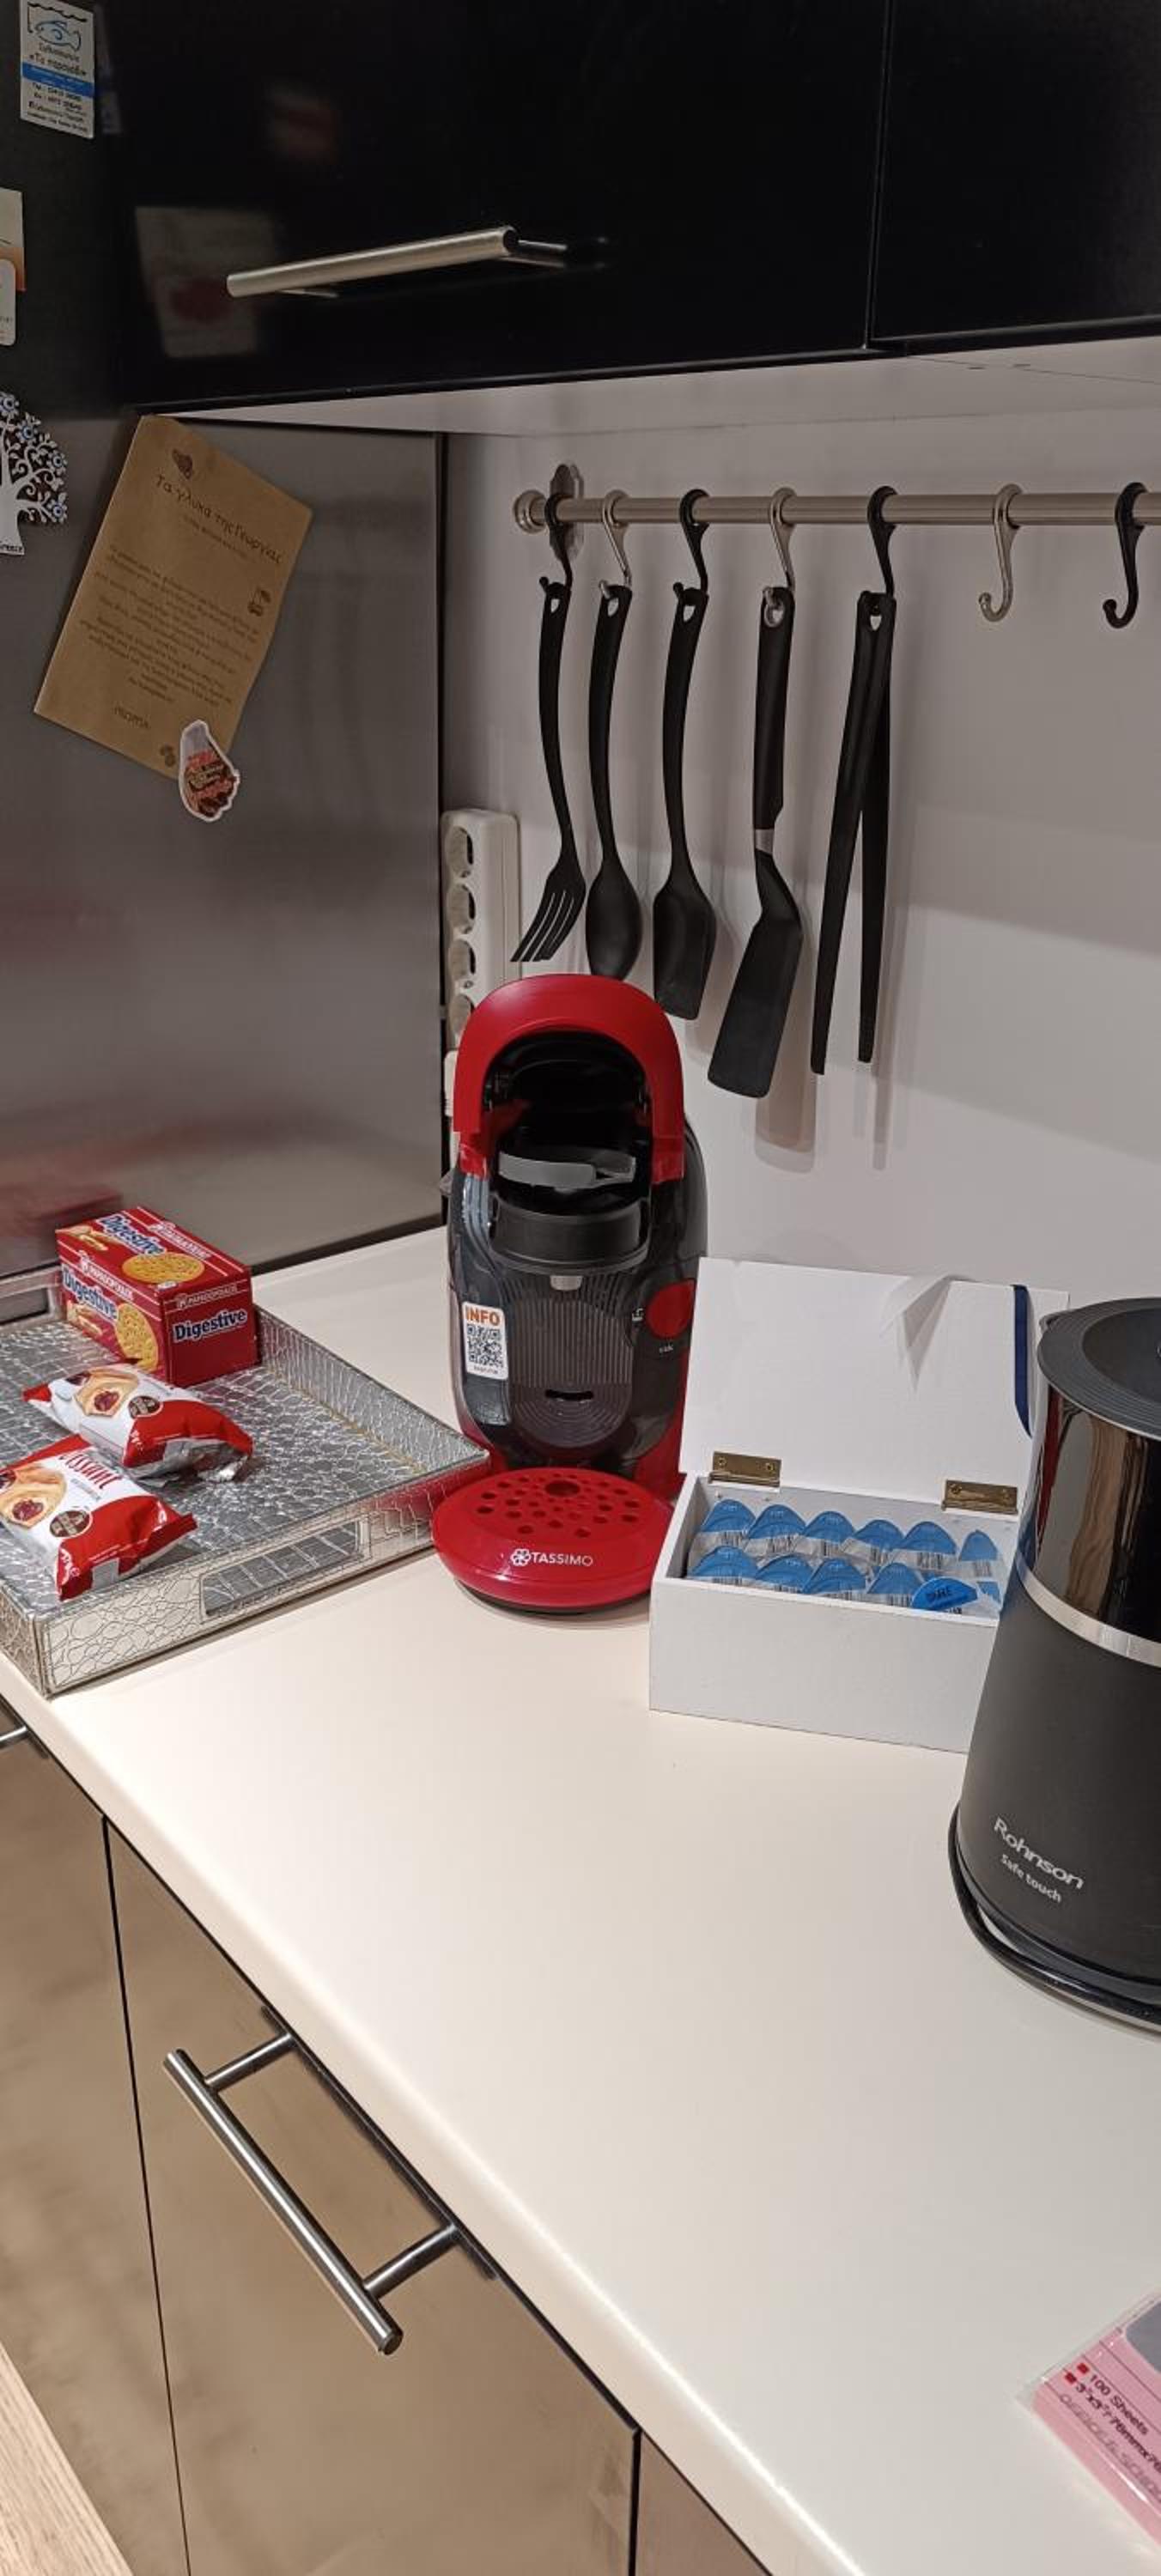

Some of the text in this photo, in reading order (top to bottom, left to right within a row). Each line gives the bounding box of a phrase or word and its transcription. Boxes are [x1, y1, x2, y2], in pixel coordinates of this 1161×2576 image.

[100, 1215, 167, 1255] Digestive
[62, 1265, 119, 1322] Digestive
[465, 1304, 501, 1327] INFO
[174, 1309, 246, 1340] Digestive
[531, 1551, 593, 1567] TASSIMO
[994, 1816, 1084, 1889] Rohnson
[1000, 1854, 1061, 1903] Safe touch
[1090, 2374, 1149, 2435] 100 Sheets
